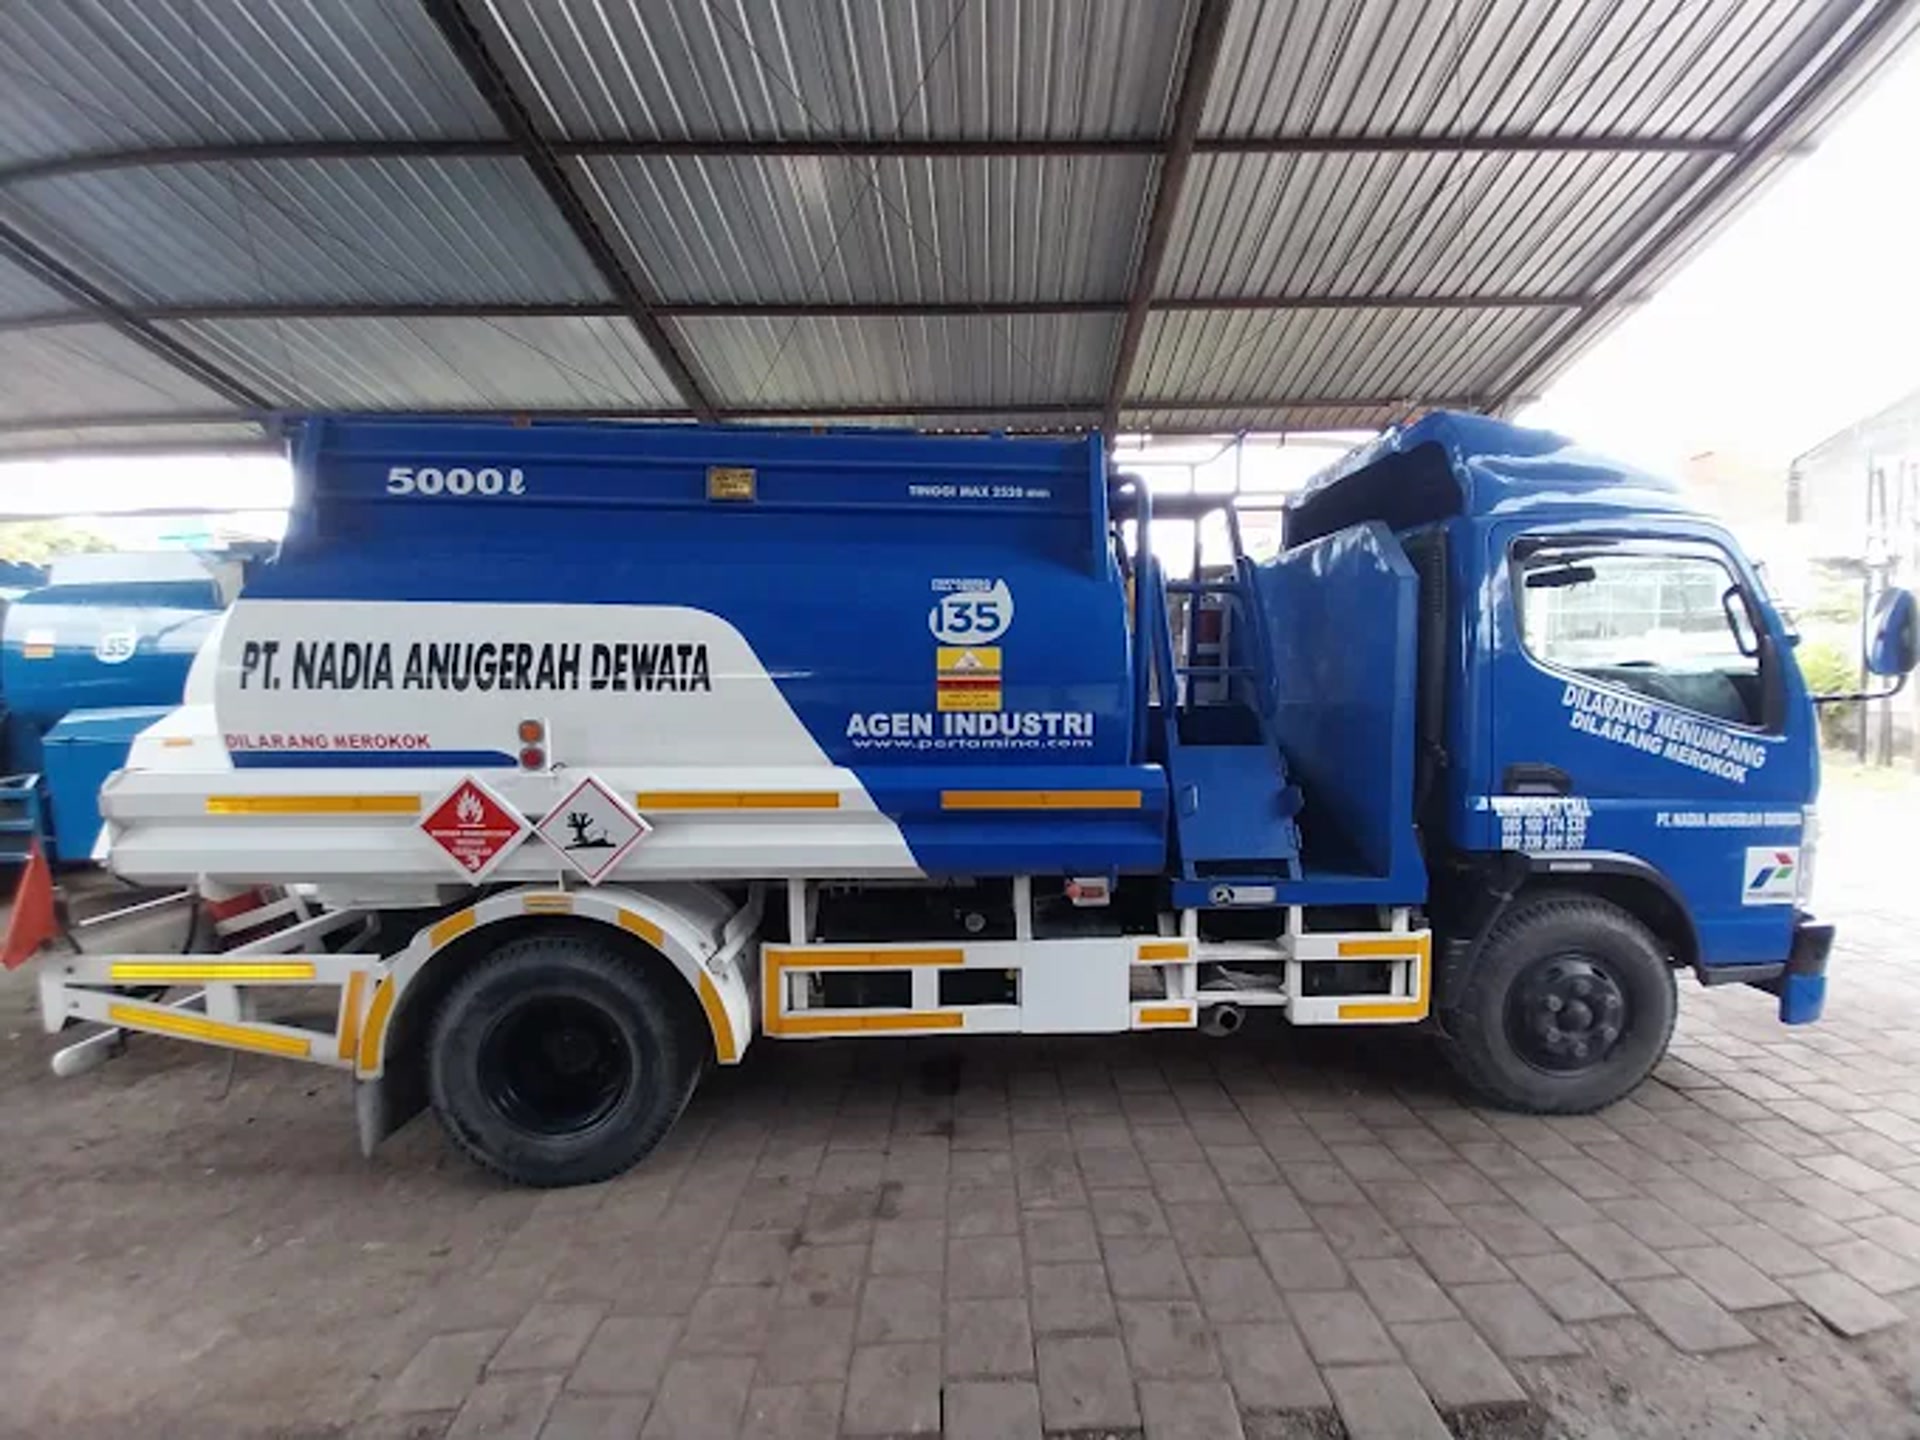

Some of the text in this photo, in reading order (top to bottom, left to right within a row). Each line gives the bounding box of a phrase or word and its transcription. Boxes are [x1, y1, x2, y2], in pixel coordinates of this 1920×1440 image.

[959, 485, 990, 498] MAX
[935, 601, 1001, 633] 135
[240, 641, 712, 692] PT. NADIA ANUGERAH DEWATA
[846, 711, 1094, 737] AGEN INDUSTRI
[1561, 684, 1767, 769] DILARANG MENUMPANG
[224, 733, 432, 749] DILARANG MEROKOK
[1569, 711, 1750, 784] DILARANG MEROKOK
